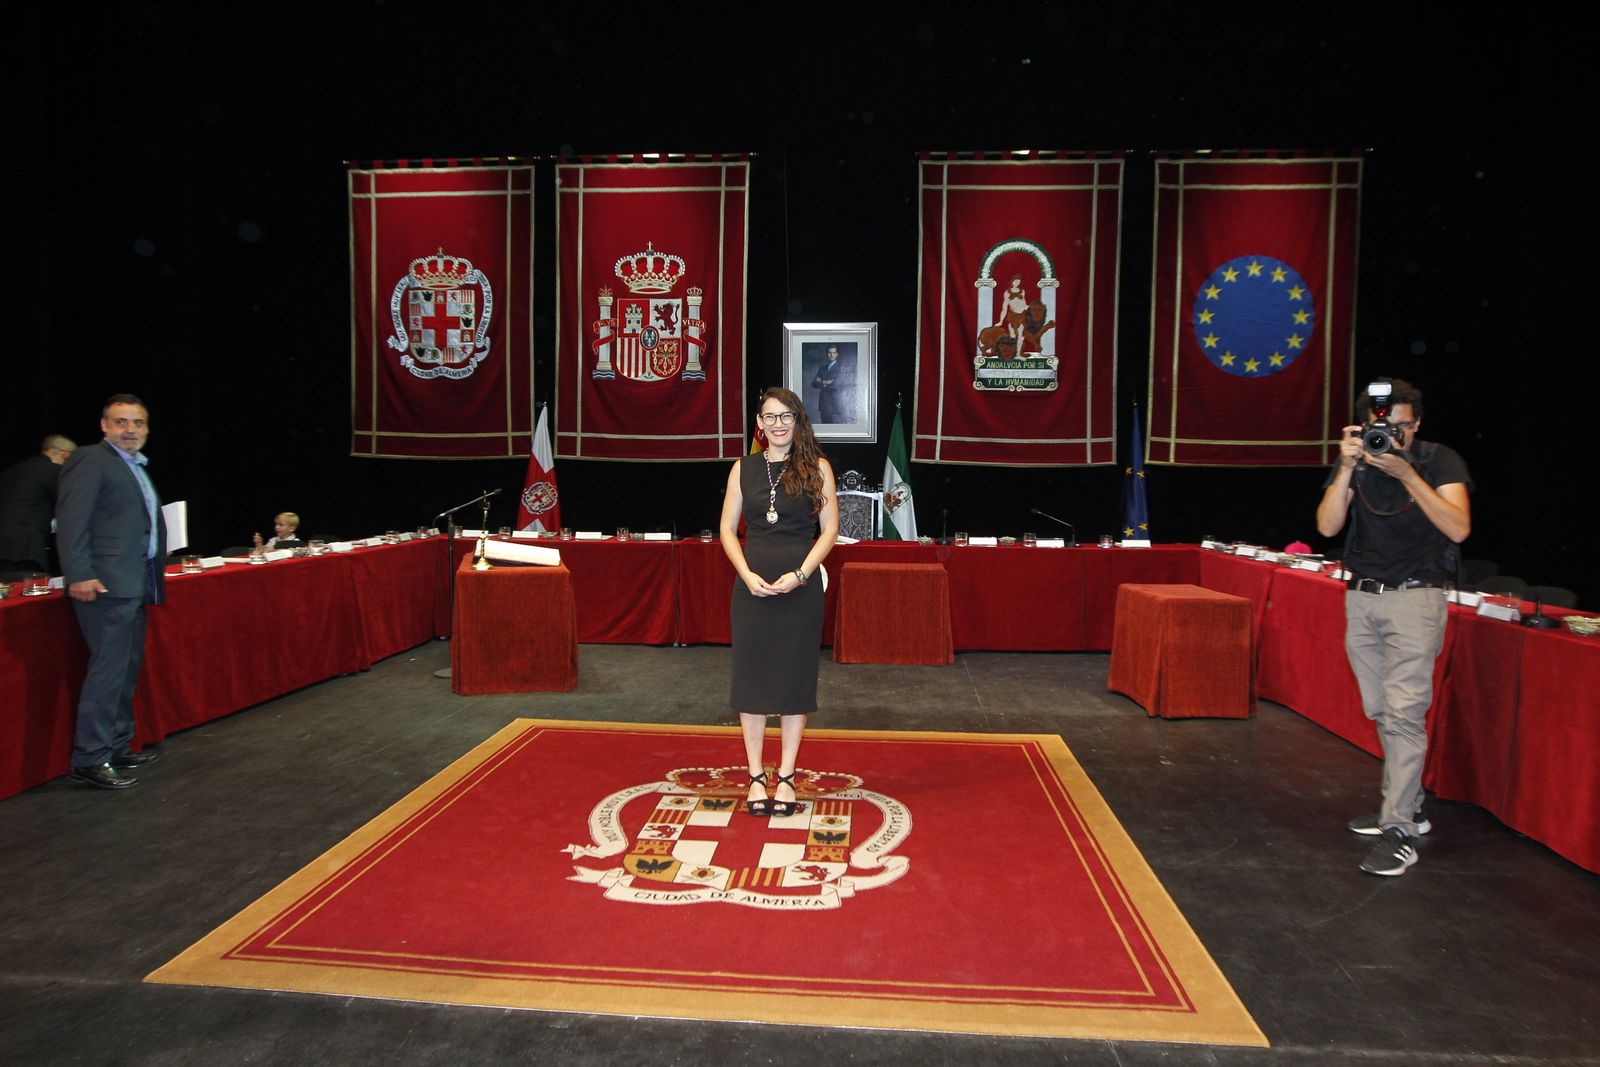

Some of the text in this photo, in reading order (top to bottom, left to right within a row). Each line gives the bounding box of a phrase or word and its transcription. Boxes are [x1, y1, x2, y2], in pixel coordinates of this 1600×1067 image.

[1023, 361, 1036, 369] POR
[987, 378, 992, 386] Y
[634, 891, 702, 901] CIUDAD
[709, 891, 734, 899] DE
